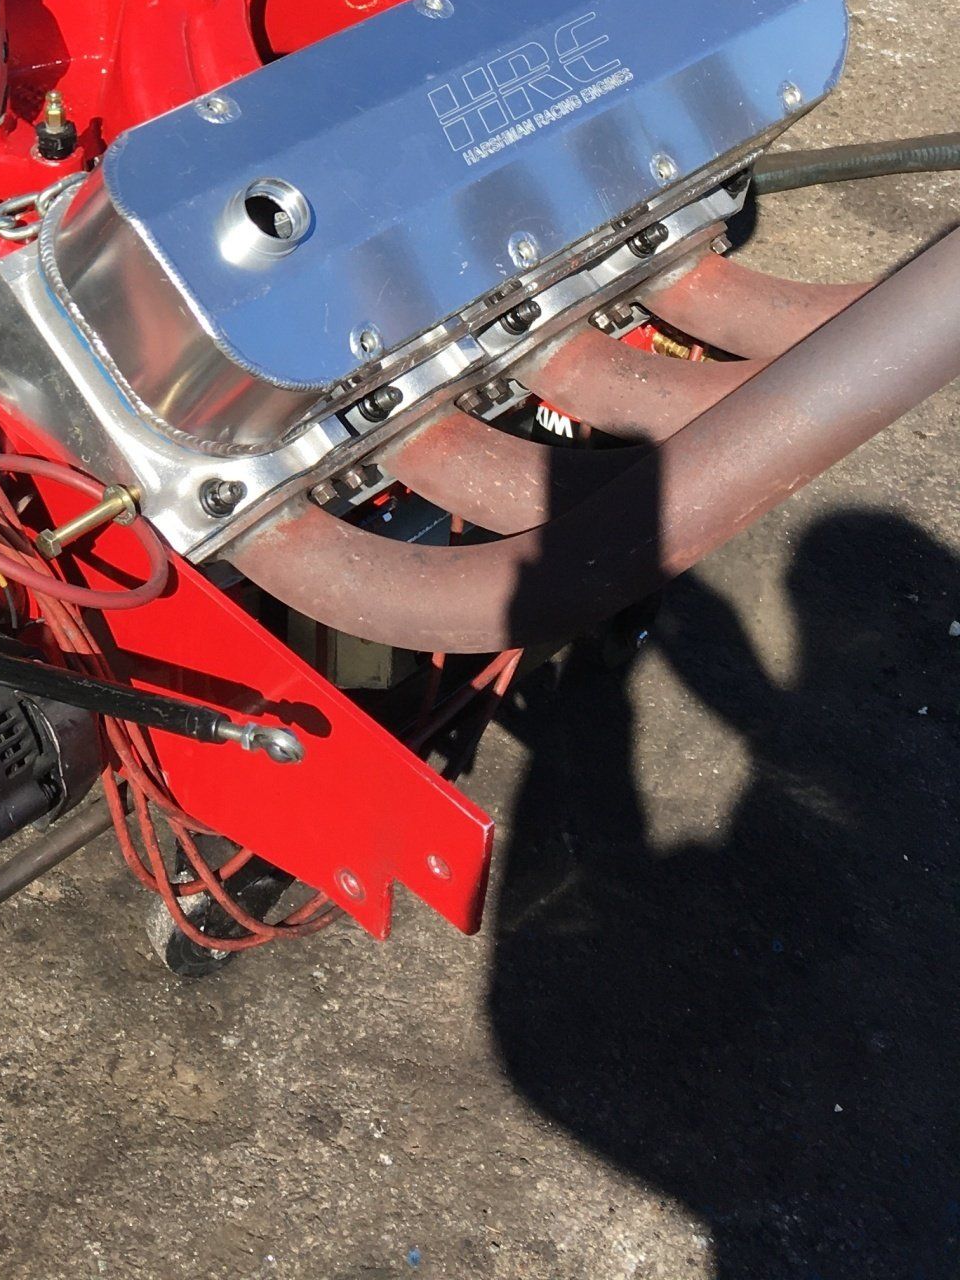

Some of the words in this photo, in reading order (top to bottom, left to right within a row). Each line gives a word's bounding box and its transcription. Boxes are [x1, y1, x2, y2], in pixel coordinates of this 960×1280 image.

[462, 118, 535, 166] HARSHMAN
[534, 94, 582, 128] RACING
[582, 67, 634, 103] ENGINES
[535, 405, 574, 439] WIX
